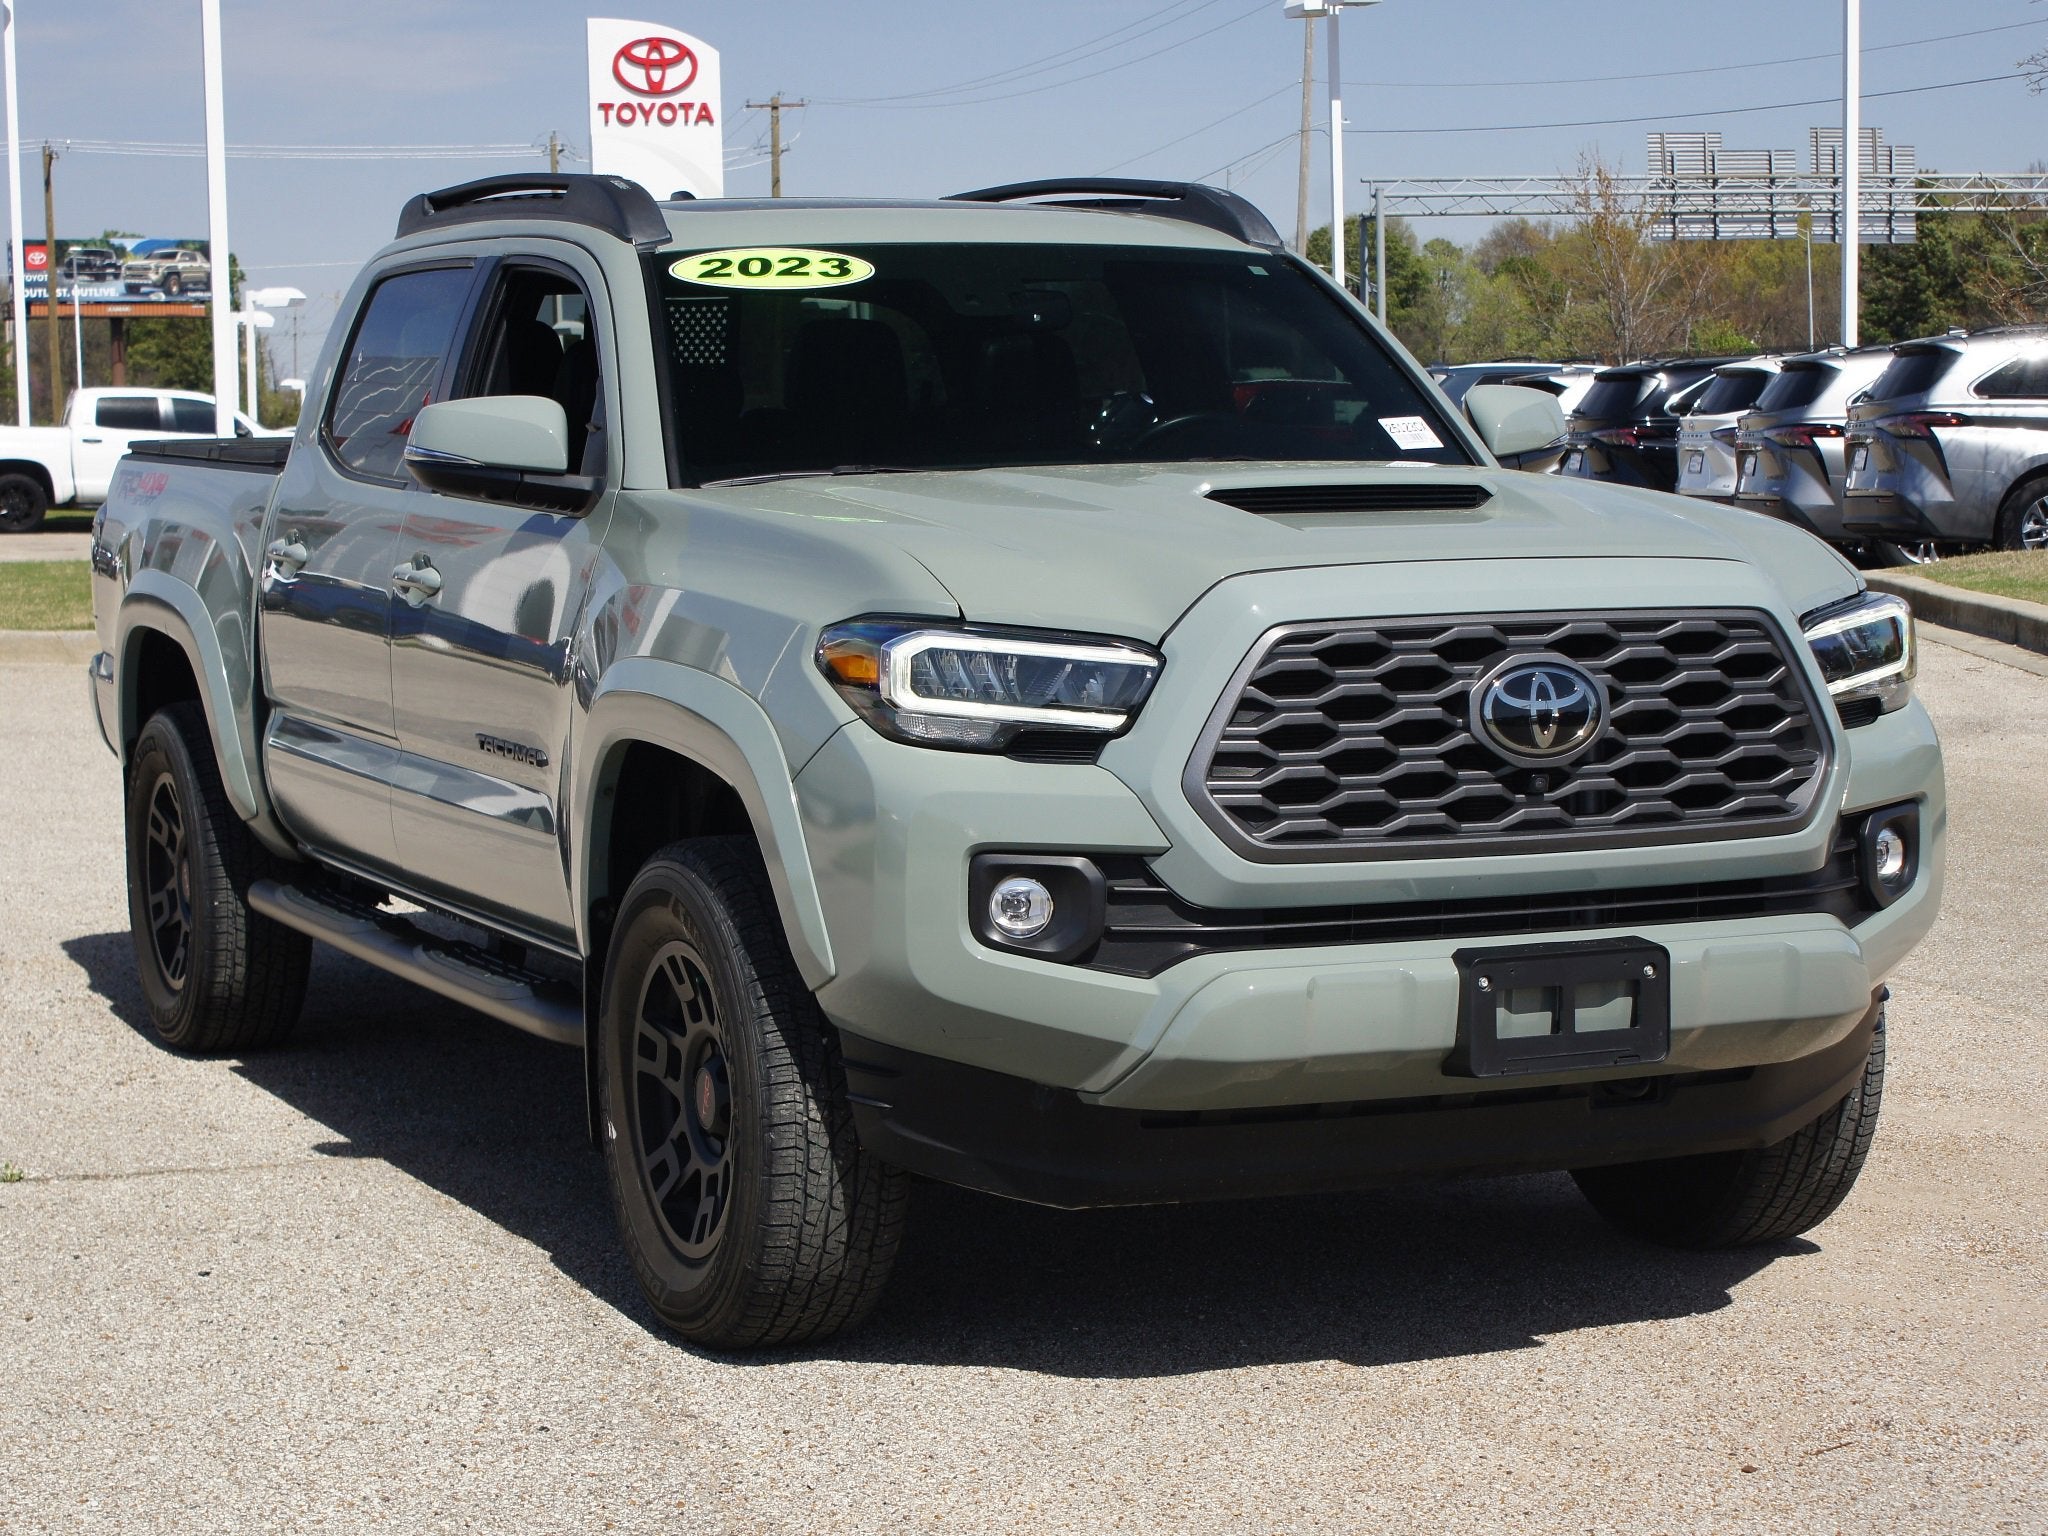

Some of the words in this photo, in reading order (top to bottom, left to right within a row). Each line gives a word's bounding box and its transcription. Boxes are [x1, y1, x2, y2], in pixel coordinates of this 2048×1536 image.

[598, 102, 714, 125] TOYOTA
[697, 257, 853, 279] 2023
[24, 287, 70, 298] OUTLST.
[475, 733, 538, 766] TACOMA
